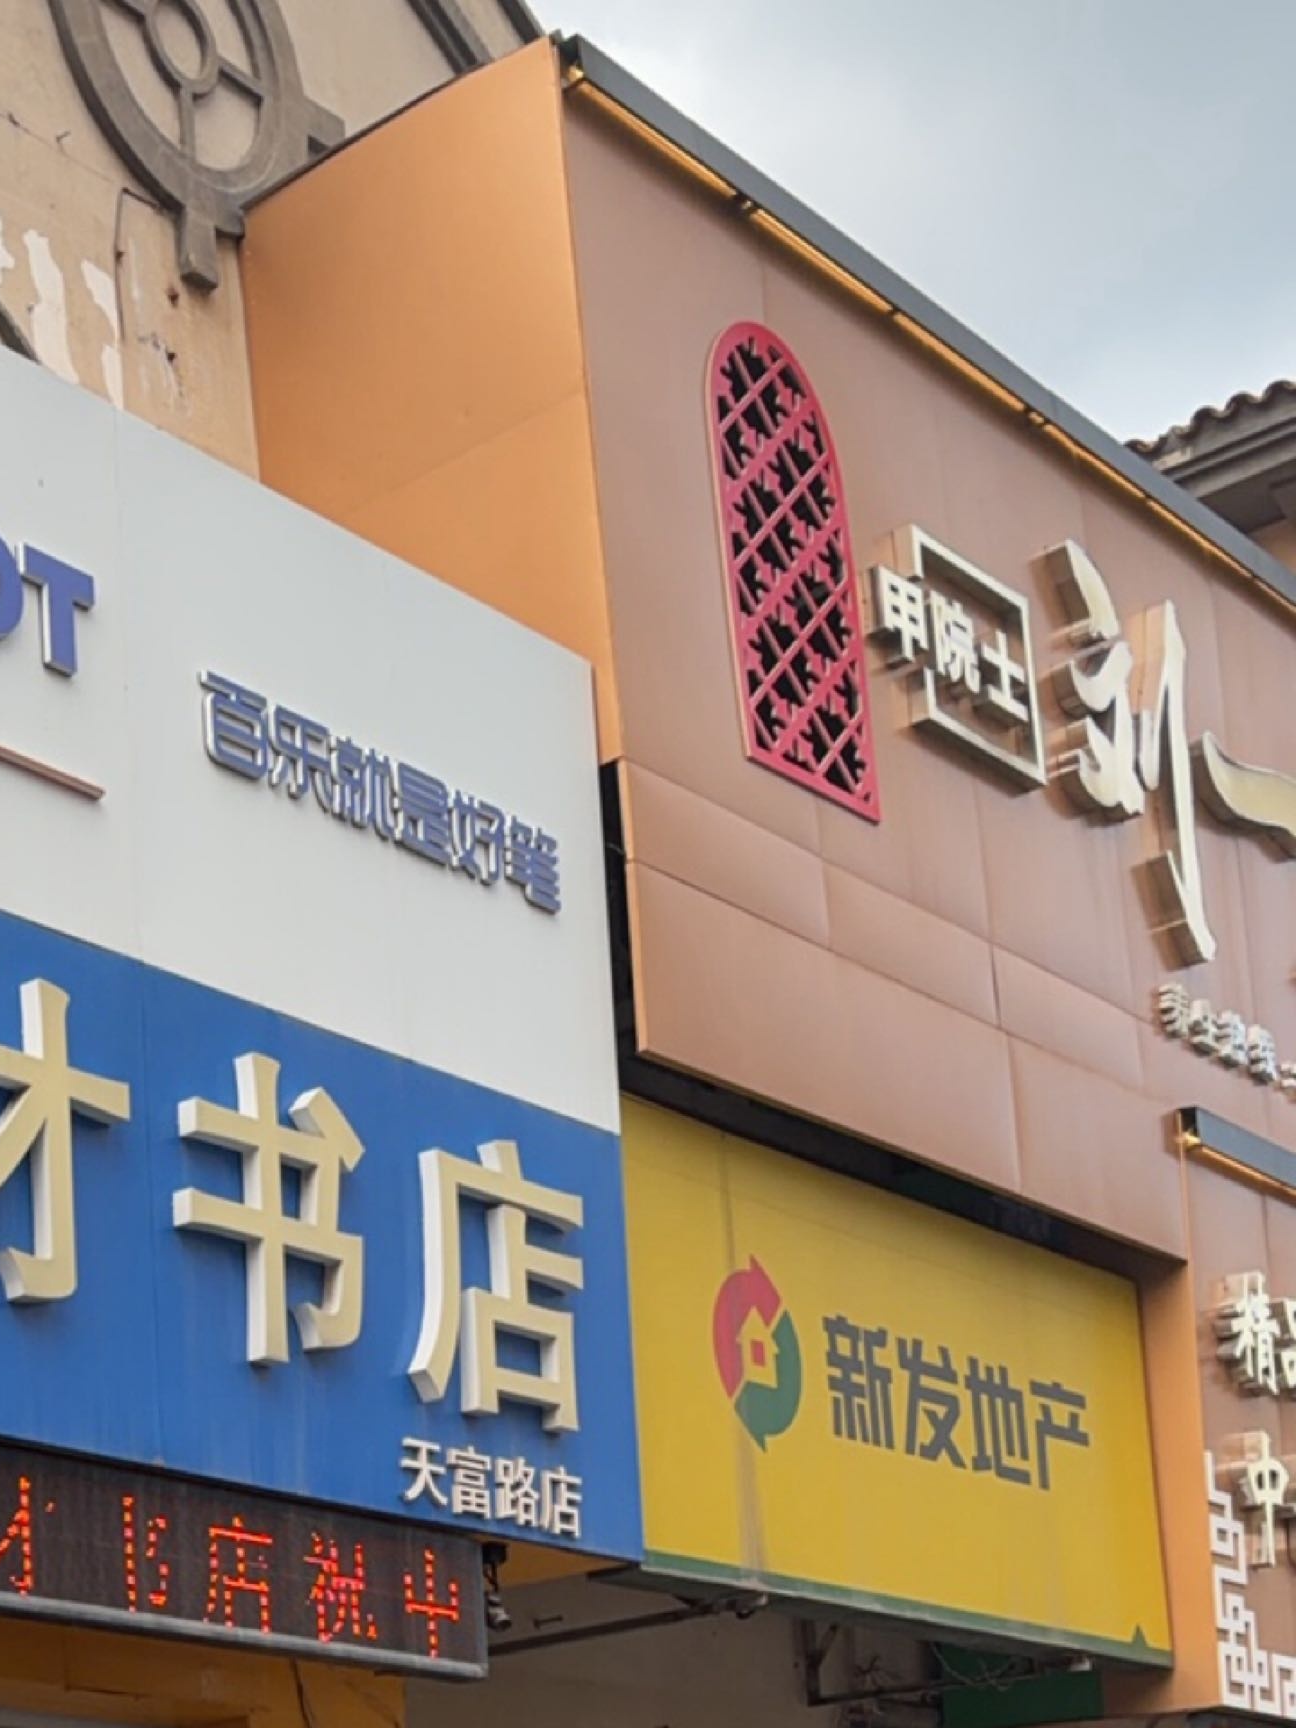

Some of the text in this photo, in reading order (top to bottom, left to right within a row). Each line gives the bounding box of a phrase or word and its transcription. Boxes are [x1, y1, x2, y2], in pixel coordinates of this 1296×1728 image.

[872, 562, 1032, 725] 甲院士
[198, 669, 562, 915] 百乐就是好笔
[822, 1313, 1091, 1491] 新发地产
[399, 1436, 583, 1539] 天富路店
